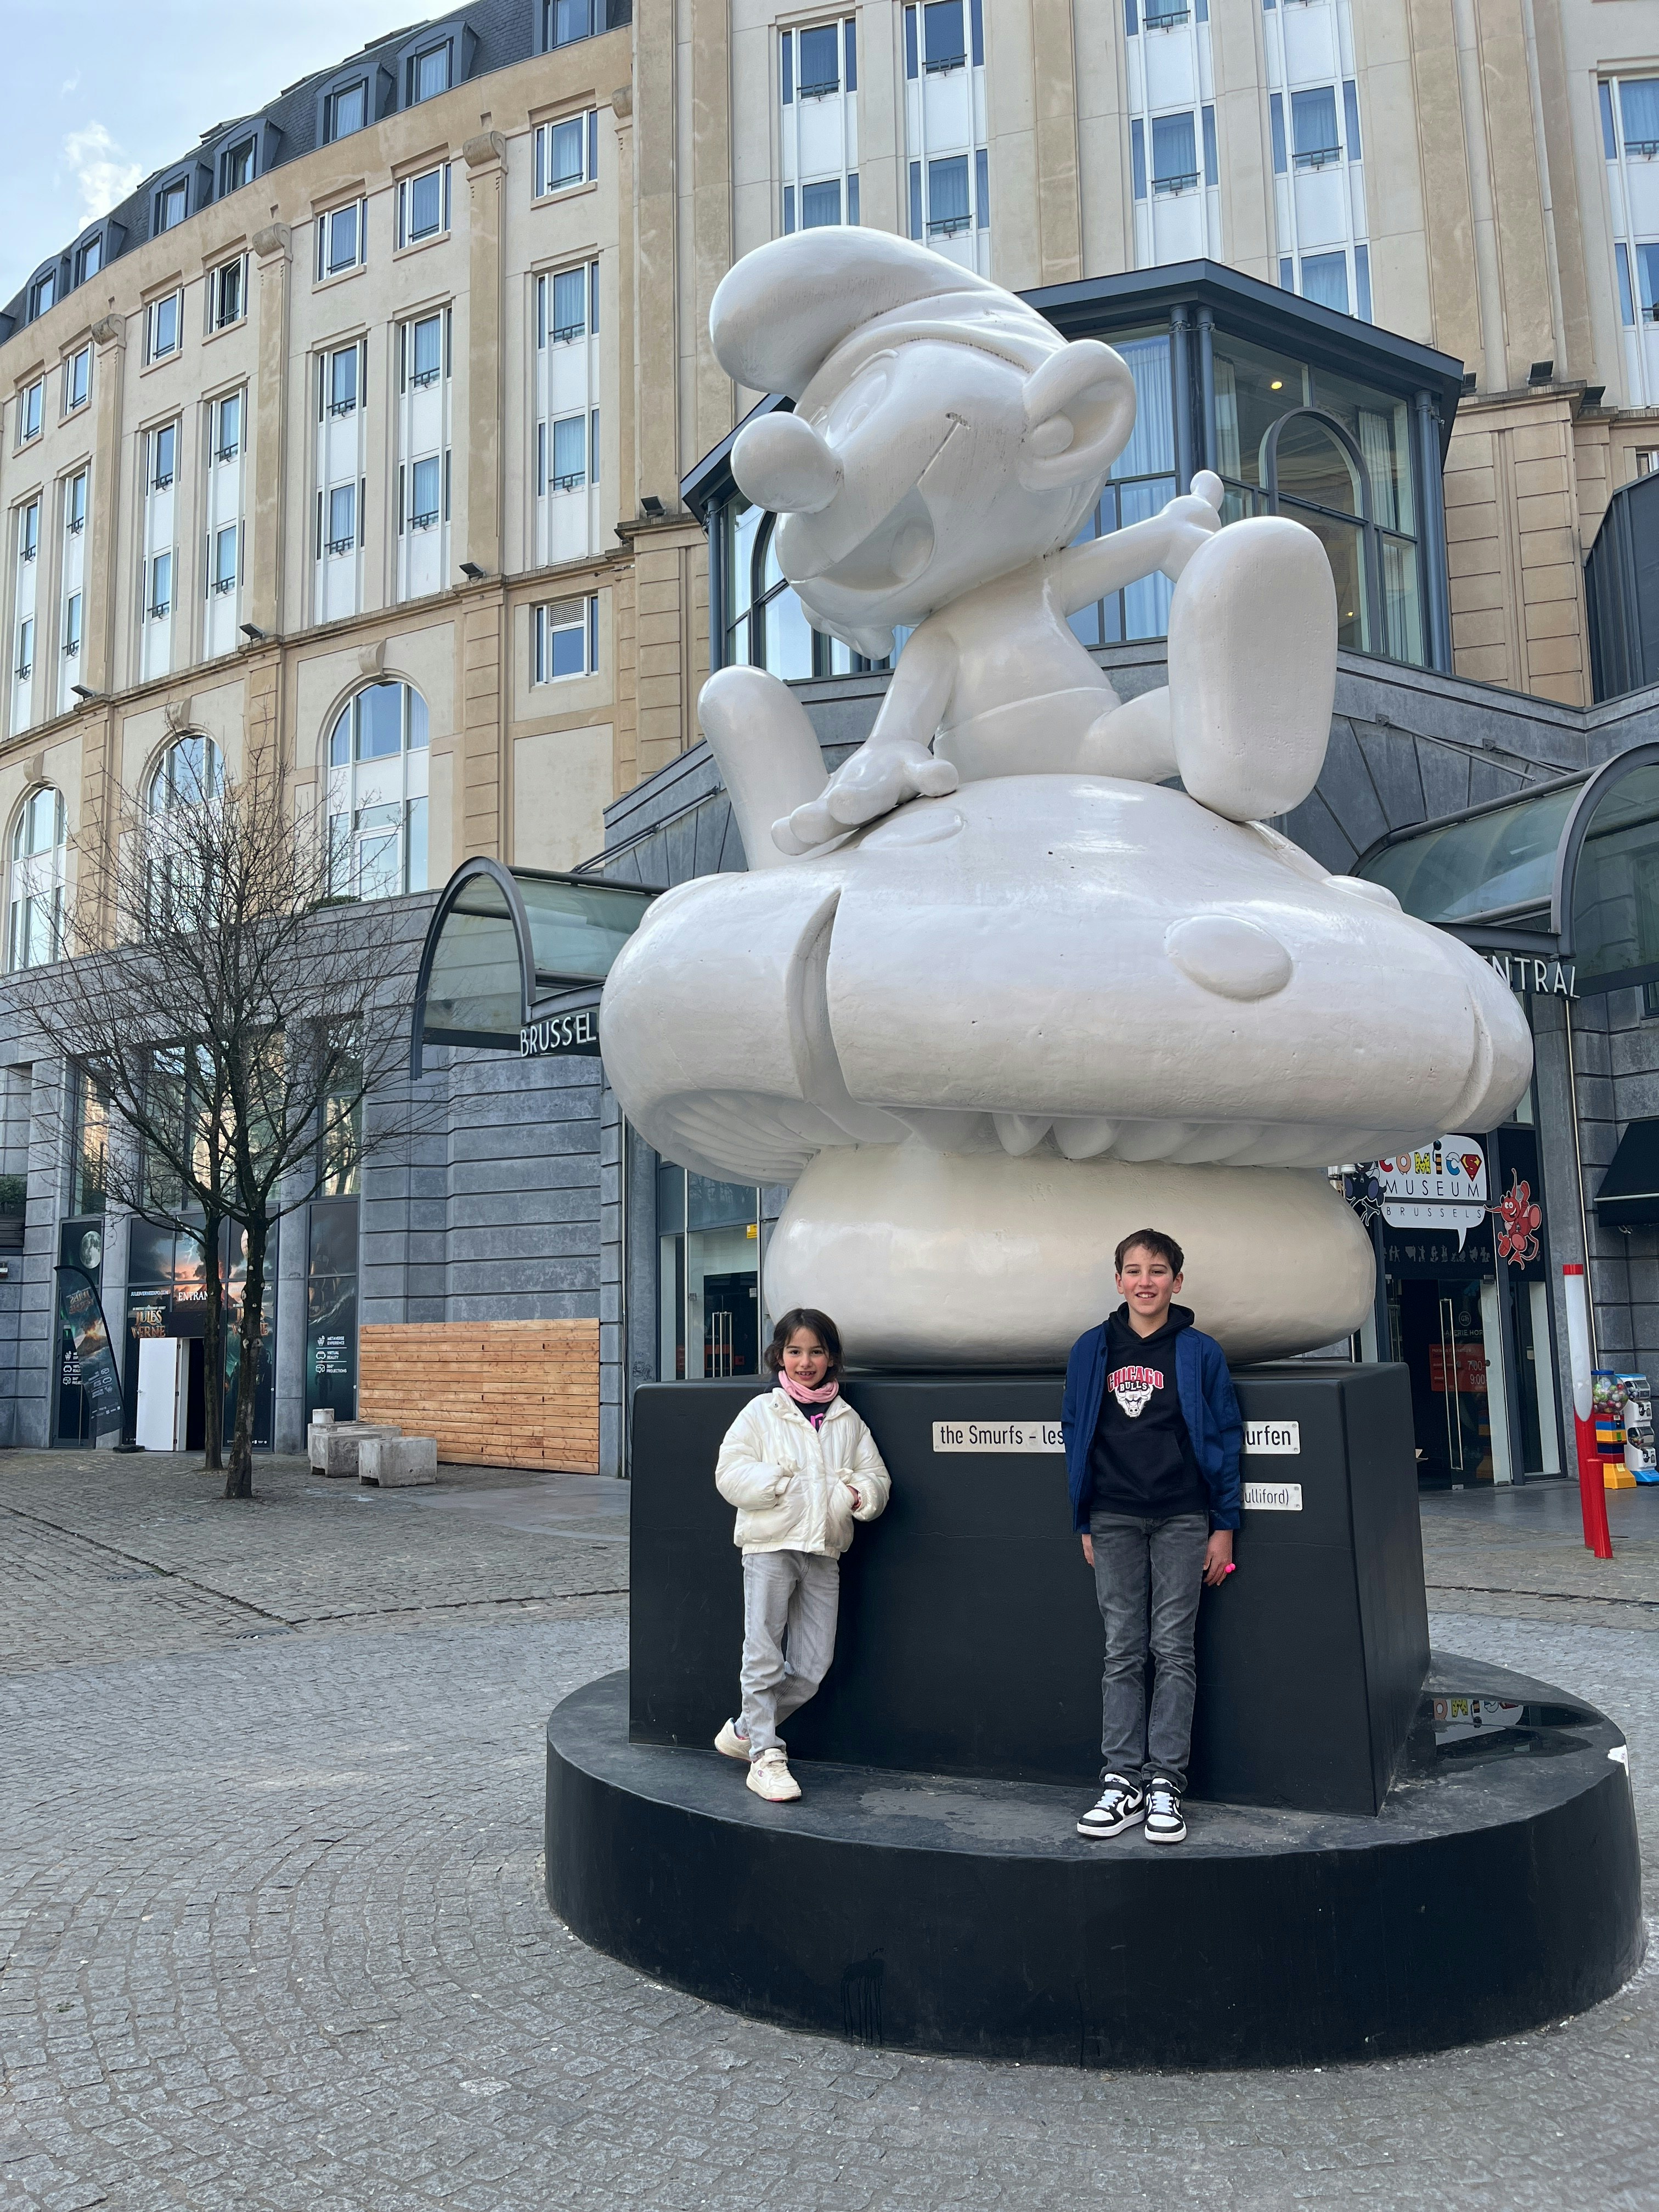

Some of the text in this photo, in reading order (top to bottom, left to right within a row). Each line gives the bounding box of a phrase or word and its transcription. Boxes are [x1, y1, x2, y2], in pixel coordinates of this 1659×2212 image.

[1481, 955, 1581, 999] NTRAL
[520, 1012, 597, 1057] BRUSSEL
[1386, 1179, 1480, 1198] MUSEUM
[1386, 1206, 1482, 1218] BRUSSELS
[178, 1291, 208, 1301] ENTRAN
[135, 1310, 162, 1325] JULES
[131, 1325, 166, 1339] VERNE
[1107, 1365, 1164, 1392] CHICAGO
[1120, 1380, 1148, 1392] BULLS
[940, 1425, 963, 1444] the
[969, 1425, 1023, 1444] Smurfs
[1043, 1425, 1065, 1444] les
[1243, 1425, 1291, 1446] urfen
